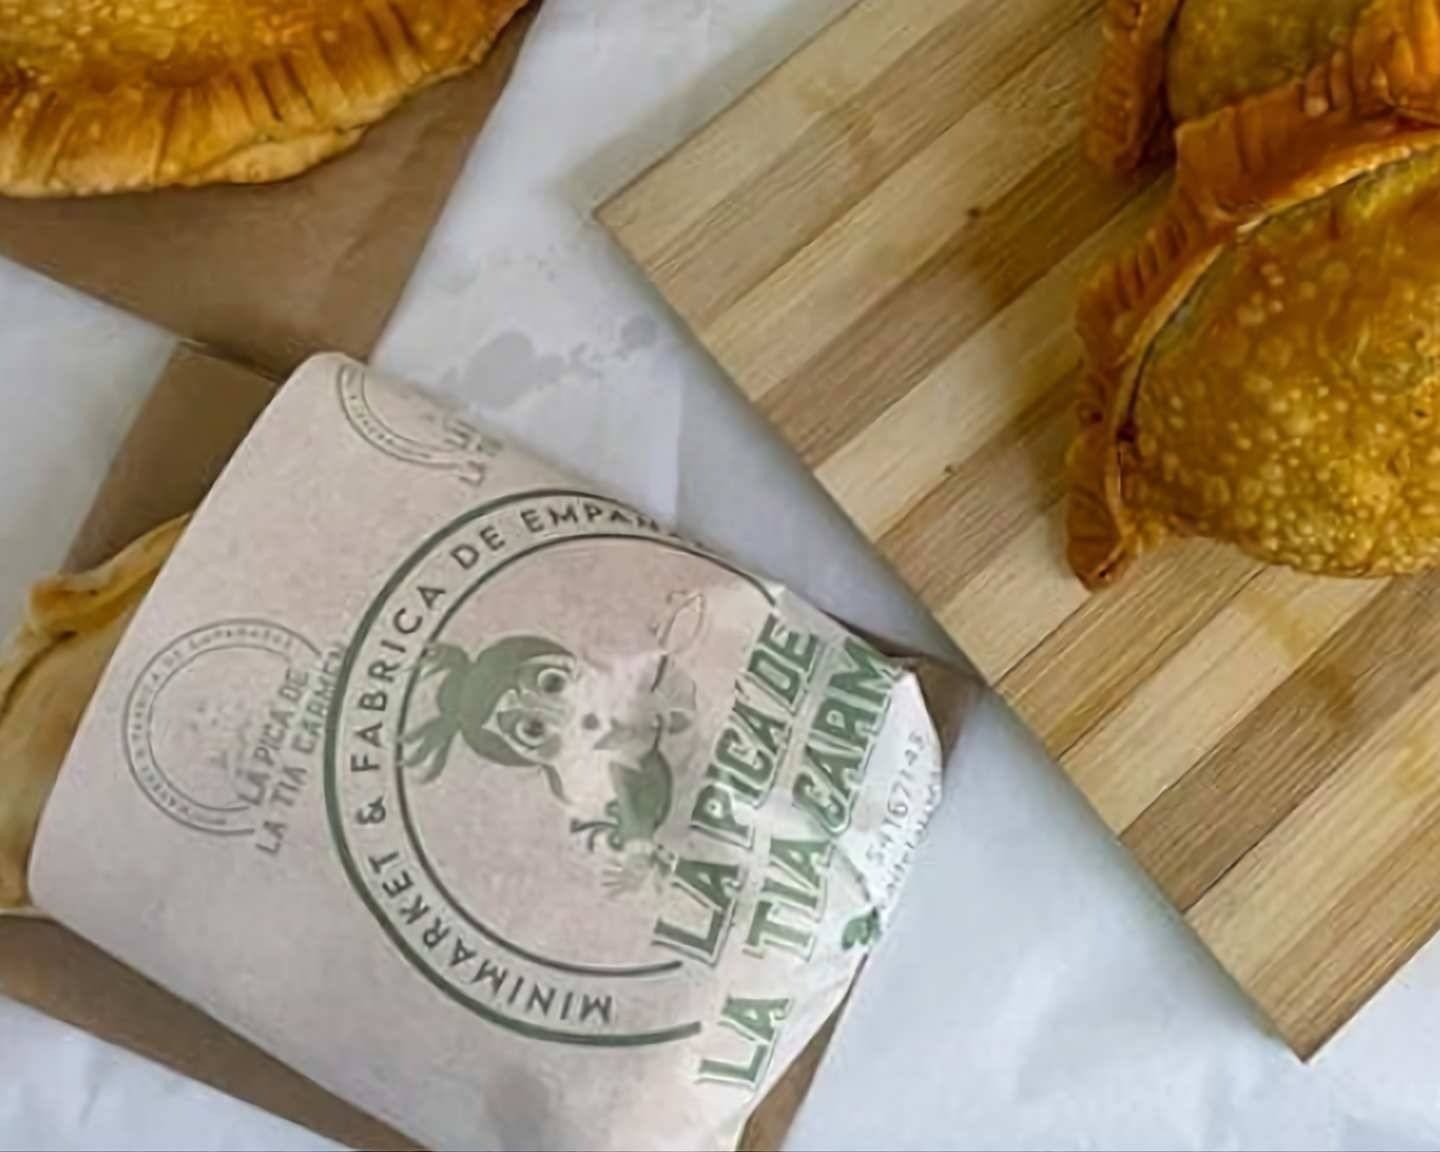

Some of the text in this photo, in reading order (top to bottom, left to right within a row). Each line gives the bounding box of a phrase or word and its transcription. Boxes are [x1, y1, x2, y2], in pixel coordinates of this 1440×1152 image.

[450, 524, 506, 570] DE
[350, 584, 447, 774] FABRICA
[238, 668, 308, 806] LA PICA DE
[270, 764, 307, 807] TIA
[652, 860, 741, 969] LA
[747, 613, 820, 716] DE
[255, 820, 286, 856] LA
[355, 796, 387, 825] &
[368, 849, 613, 1024] MINIMARKET
[743, 838, 833, 962] TIA
[696, 995, 793, 1091] LA
